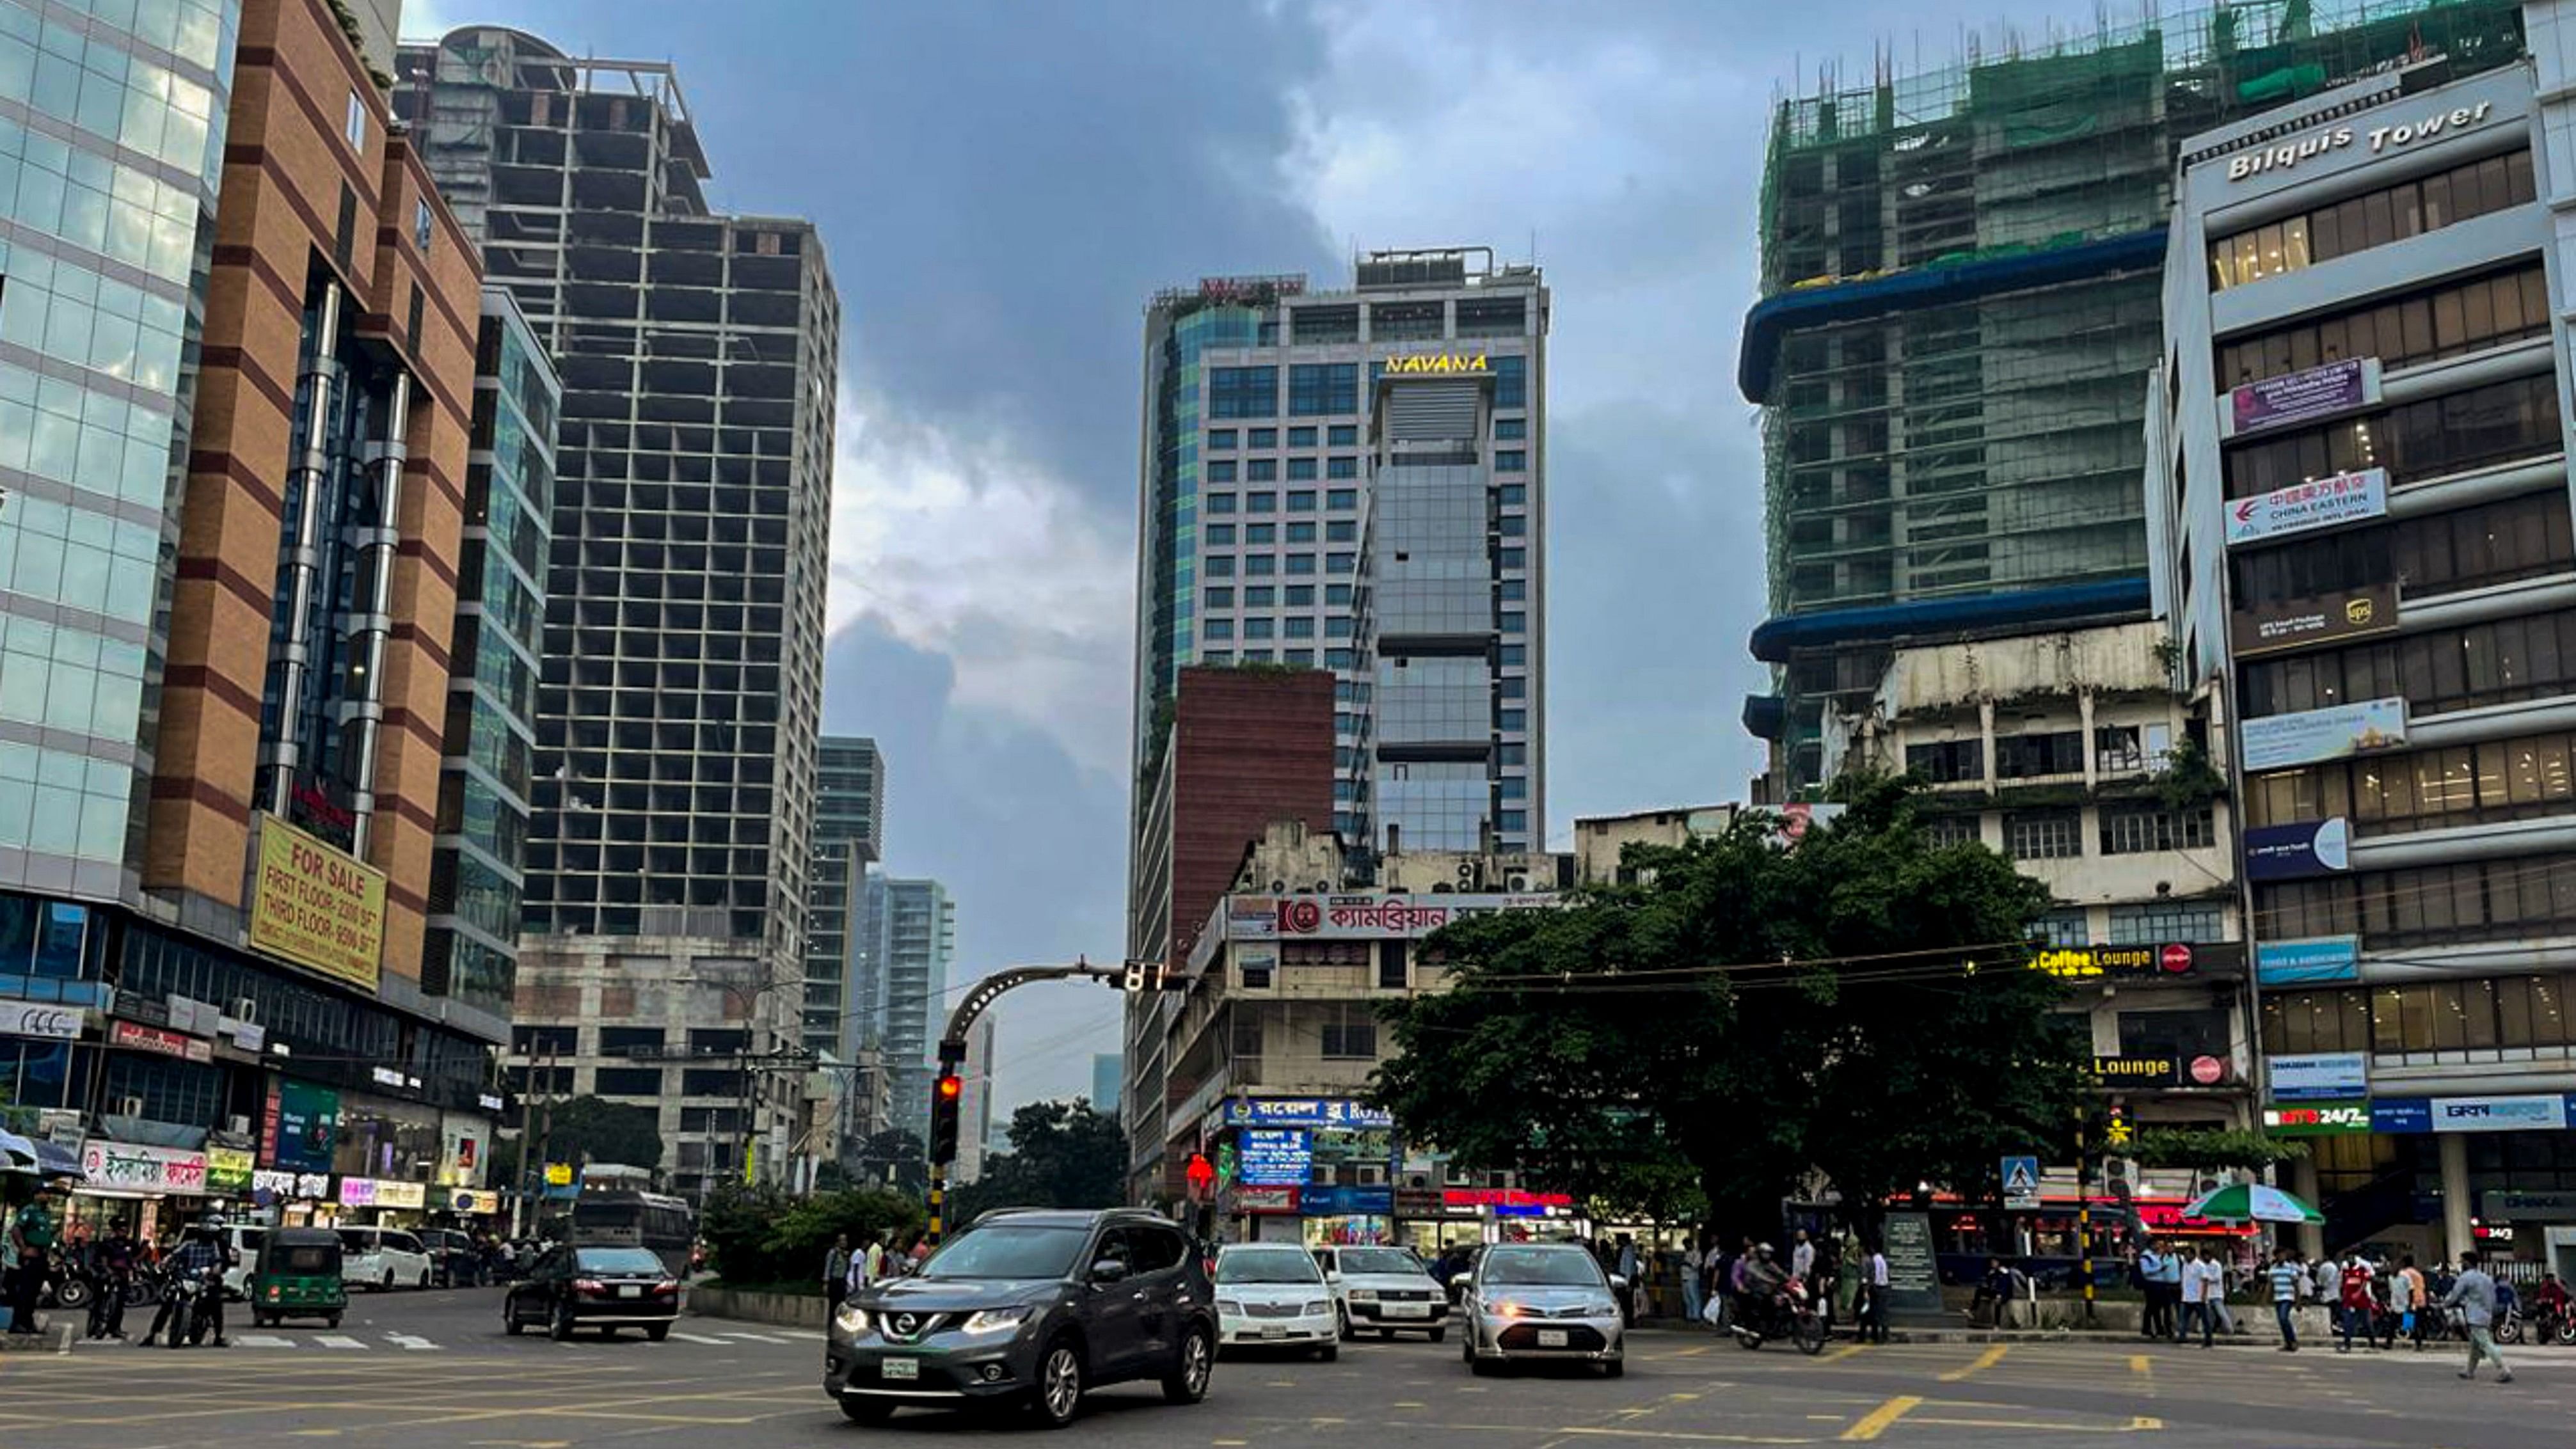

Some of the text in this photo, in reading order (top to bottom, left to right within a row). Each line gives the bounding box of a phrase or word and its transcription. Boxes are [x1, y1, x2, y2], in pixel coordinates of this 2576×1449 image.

[2227, 100, 2492, 182] Bilquis Tower
[1385, 354, 1487, 372] NAVANA
[2270, 493, 2367, 519] CHINA EASTERN
[266, 865, 296, 895] FIRST
[291, 843, 365, 900] FOR SALE
[264, 892, 294, 925] THIRD
[1328, 899, 1447, 931] ক্যামব্রিয়ান
[2039, 951, 2091, 969] Coffee
[2093, 949, 2151, 968] Lounge
[2094, 1057, 2171, 1077] Lounge
